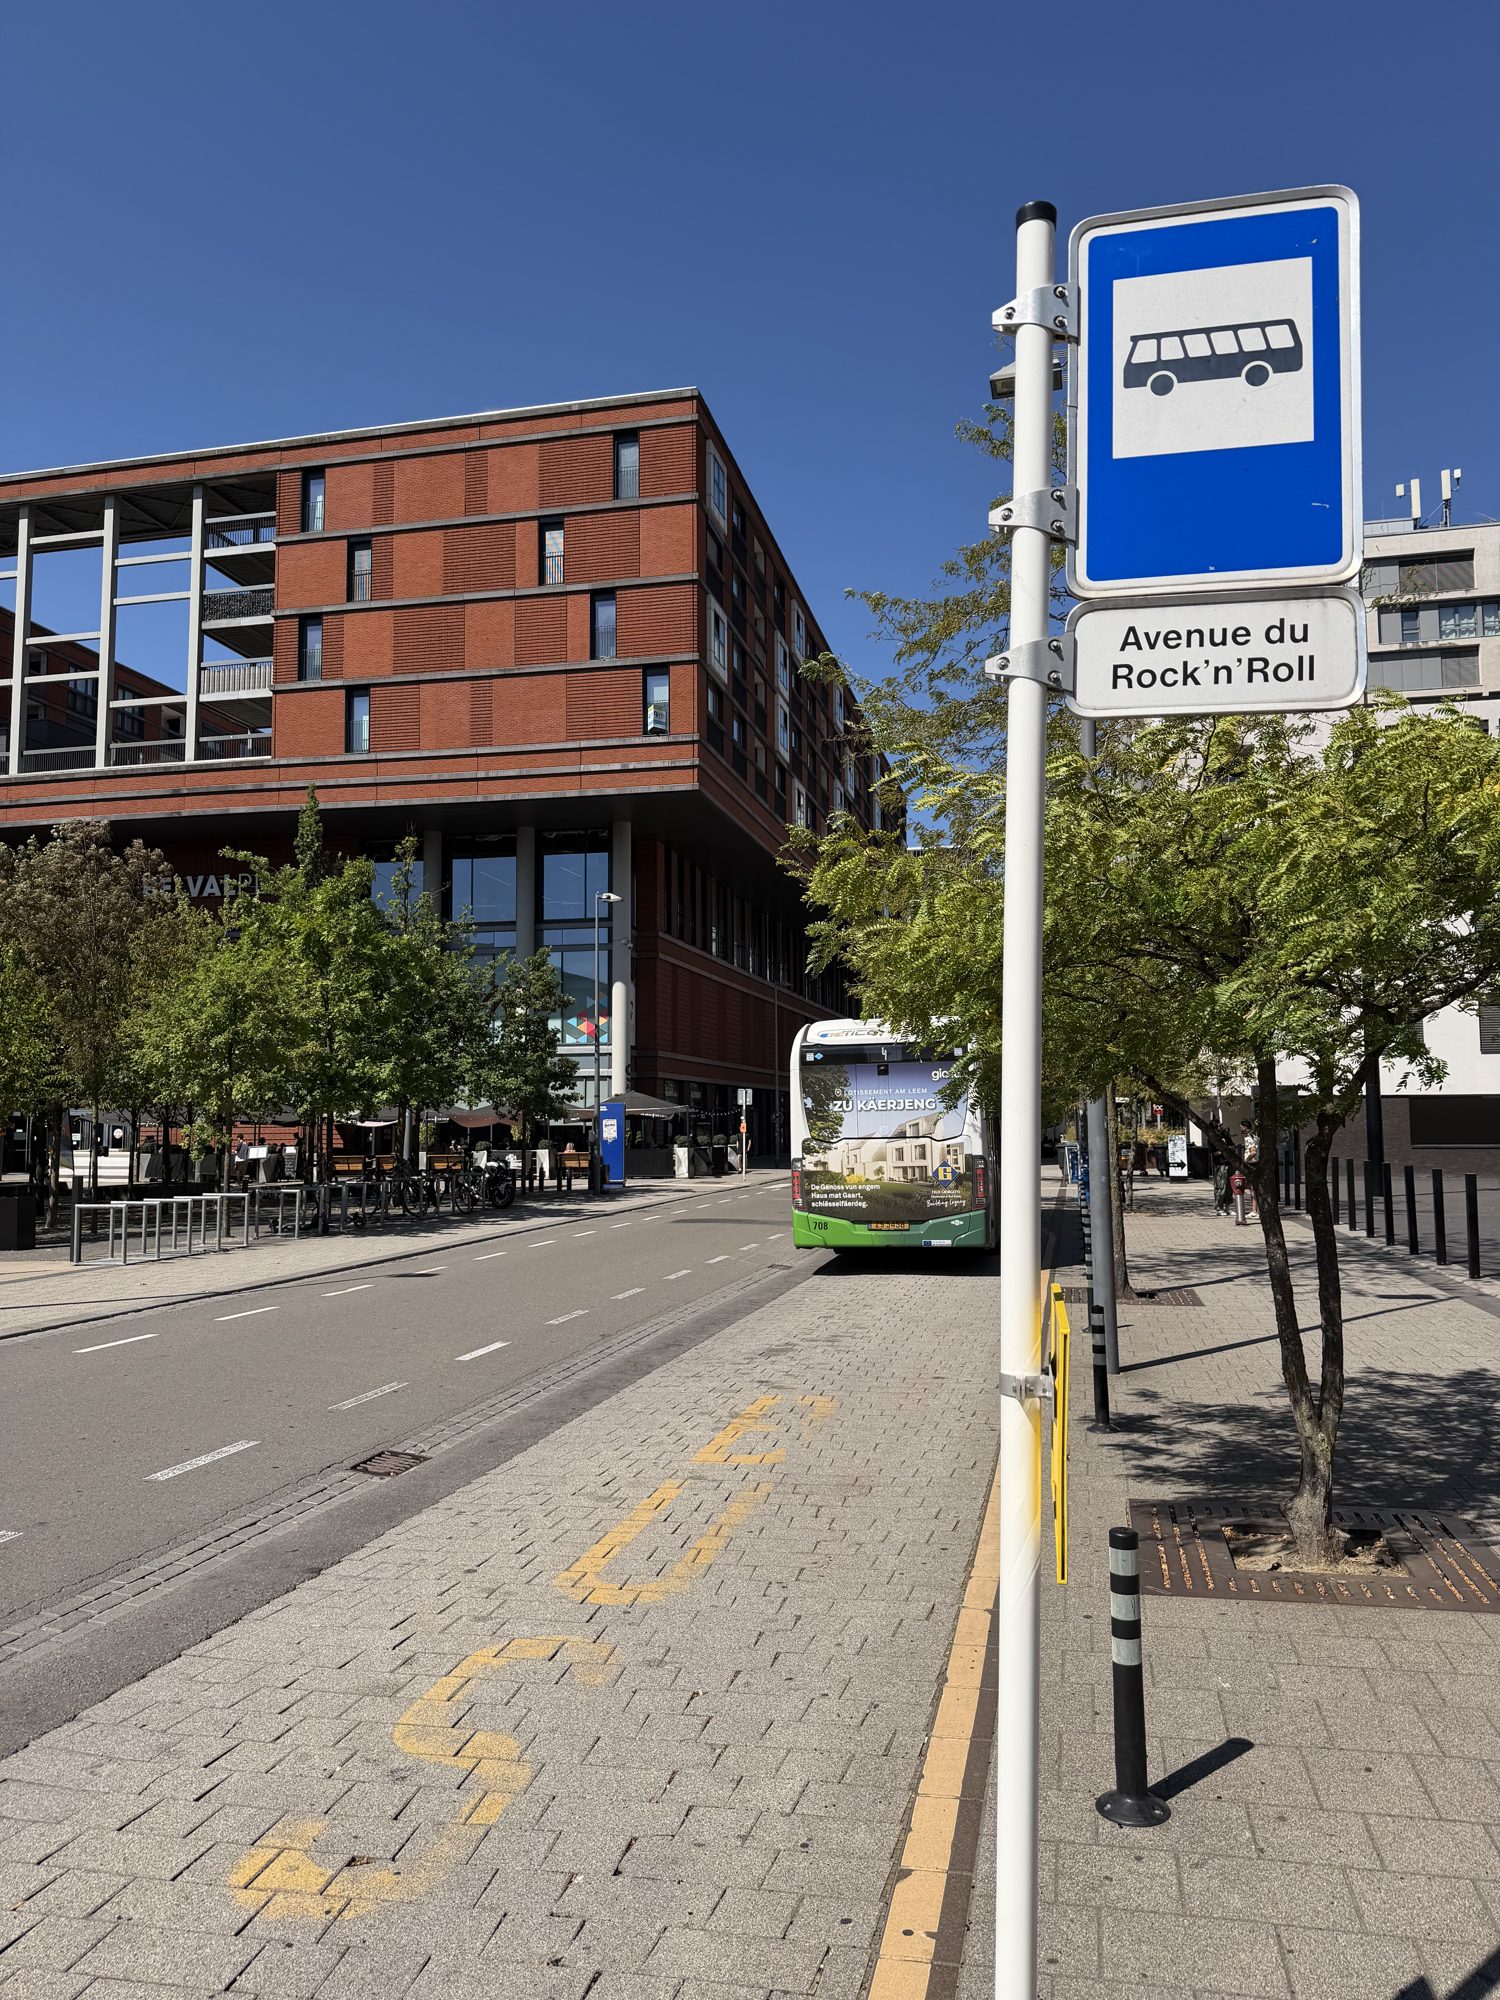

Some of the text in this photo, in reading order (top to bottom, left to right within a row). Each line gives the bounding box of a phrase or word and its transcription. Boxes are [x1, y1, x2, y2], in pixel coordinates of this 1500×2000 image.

[1119, 617, 1309, 652] Avenue du
[1111, 654, 1316, 690] Rock'n'Roll
[881, 1046, 888, 1061] 4
[843, 1088, 892, 1096] LOTISSEMENT
[833, 1097, 936, 1112] ZU KÄERJENG
[858, 1184, 880, 1192] engem
[813, 1221, 829, 1231] 708
